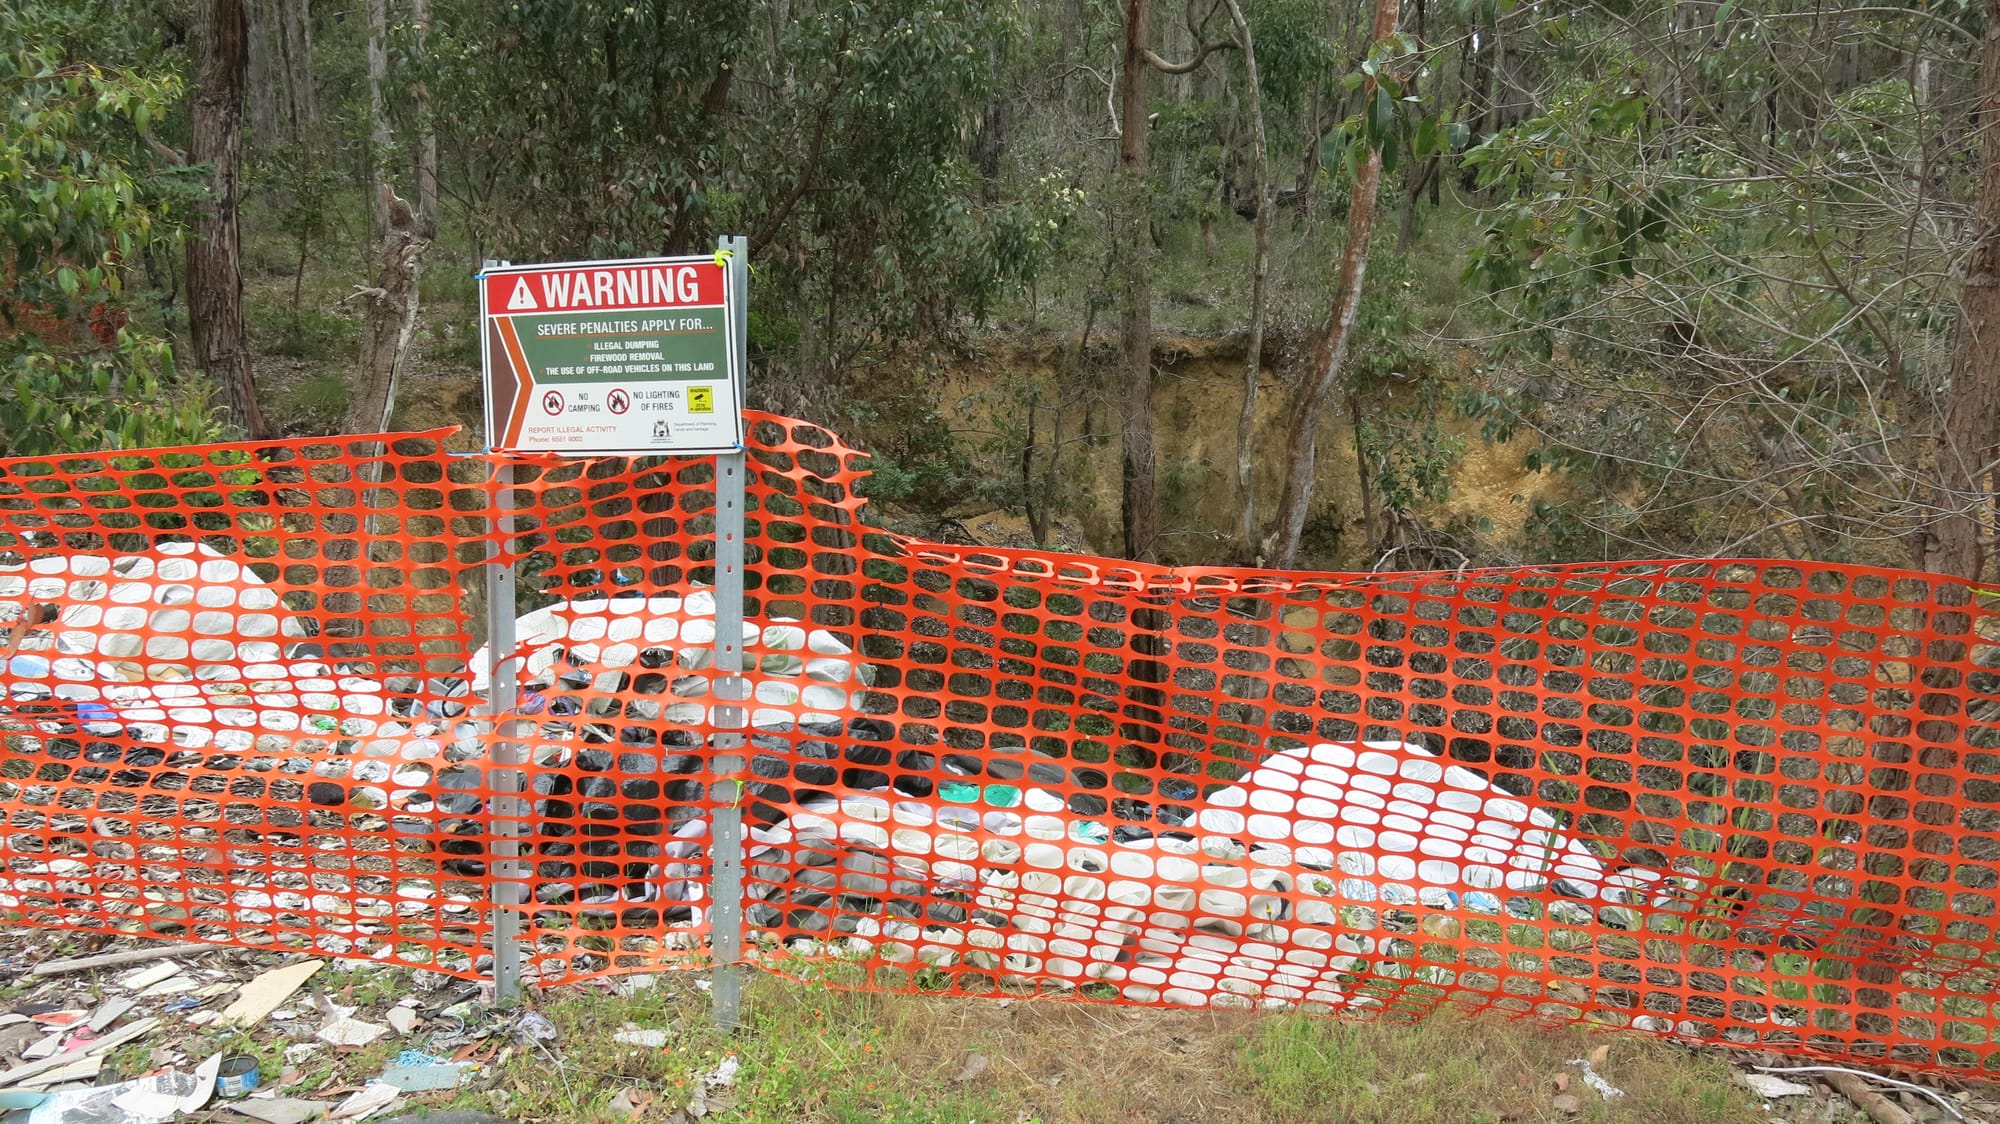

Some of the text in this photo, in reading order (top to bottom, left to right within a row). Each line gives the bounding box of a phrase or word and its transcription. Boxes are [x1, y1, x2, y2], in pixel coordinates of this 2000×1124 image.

[541, 266, 699, 308] WARNING
[537, 318, 713, 336] SEVERE PENALTIES APPLY FOR...
[593, 340, 660, 351] ILLEGAL DUMPING
[590, 352, 665, 362] FIREWOOD REMOVAL
[545, 362, 715, 376] THE USE OF OFF-ROAD VEHICLES ON THIS LAND
[633, 390, 680, 400] NO LIGHTING
[568, 404, 600, 412] CAMPING
[640, 402, 674, 411] OF FIRES
